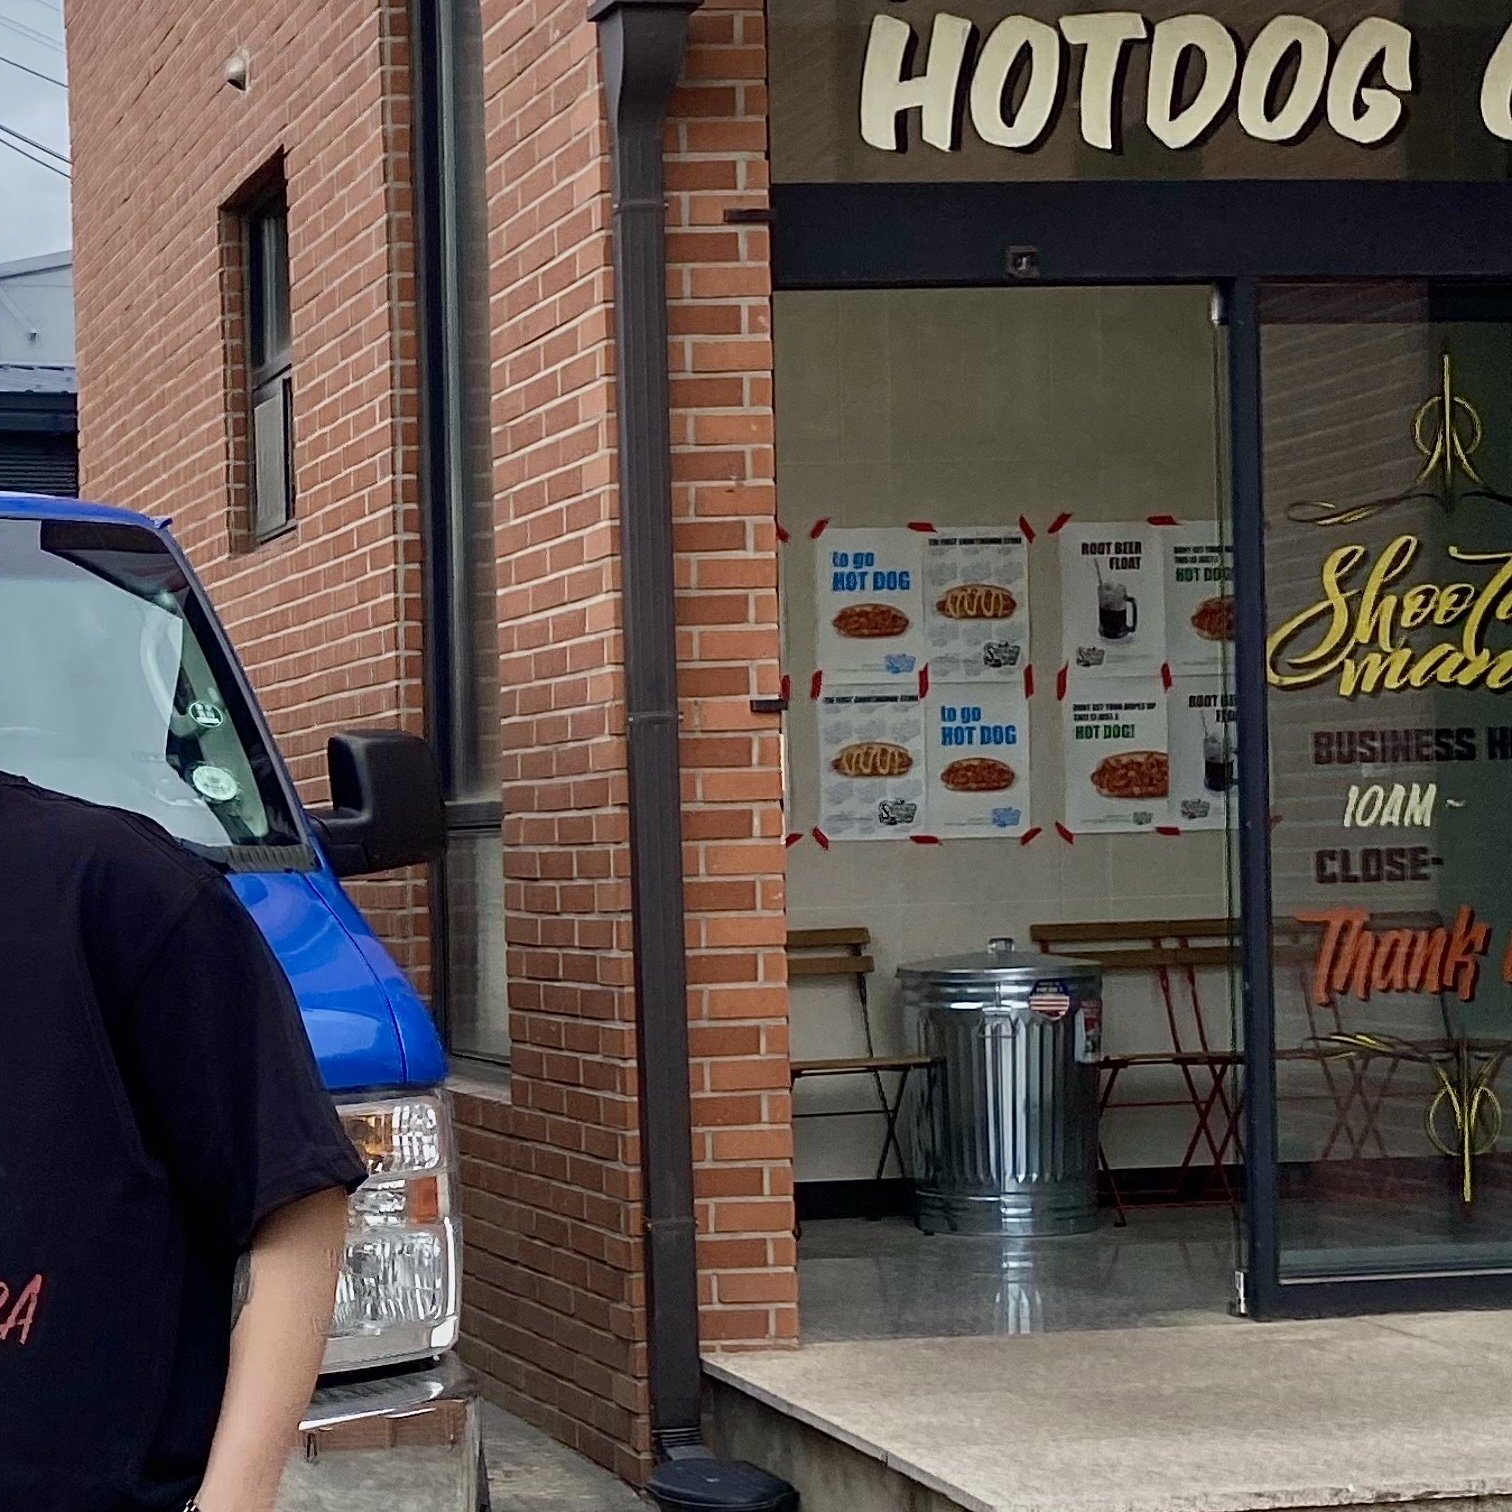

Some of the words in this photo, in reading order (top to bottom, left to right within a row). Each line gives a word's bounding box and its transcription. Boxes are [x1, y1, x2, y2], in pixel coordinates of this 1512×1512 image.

[859, 12, 1415, 153] HOTDOG
[1081, 542, 1112, 555] ROOT
[832, 551, 849, 567] to
[852, 552, 875, 569] go
[832, 571, 868, 592] HOT
[872, 570, 910, 591] DOG
[1175, 567, 1201, 583] HOT
[940, 706, 957, 722] to
[960, 706, 982, 724] go
[941, 726, 976, 746] HOT
[980, 725, 1017, 745] DOG
[1075, 724, 1100, 739] HOT
[1103, 723, 1136, 739] DOG!
[1312, 727, 1477, 765] BUSINESS
[1294, 904, 1492, 1006] Thank
